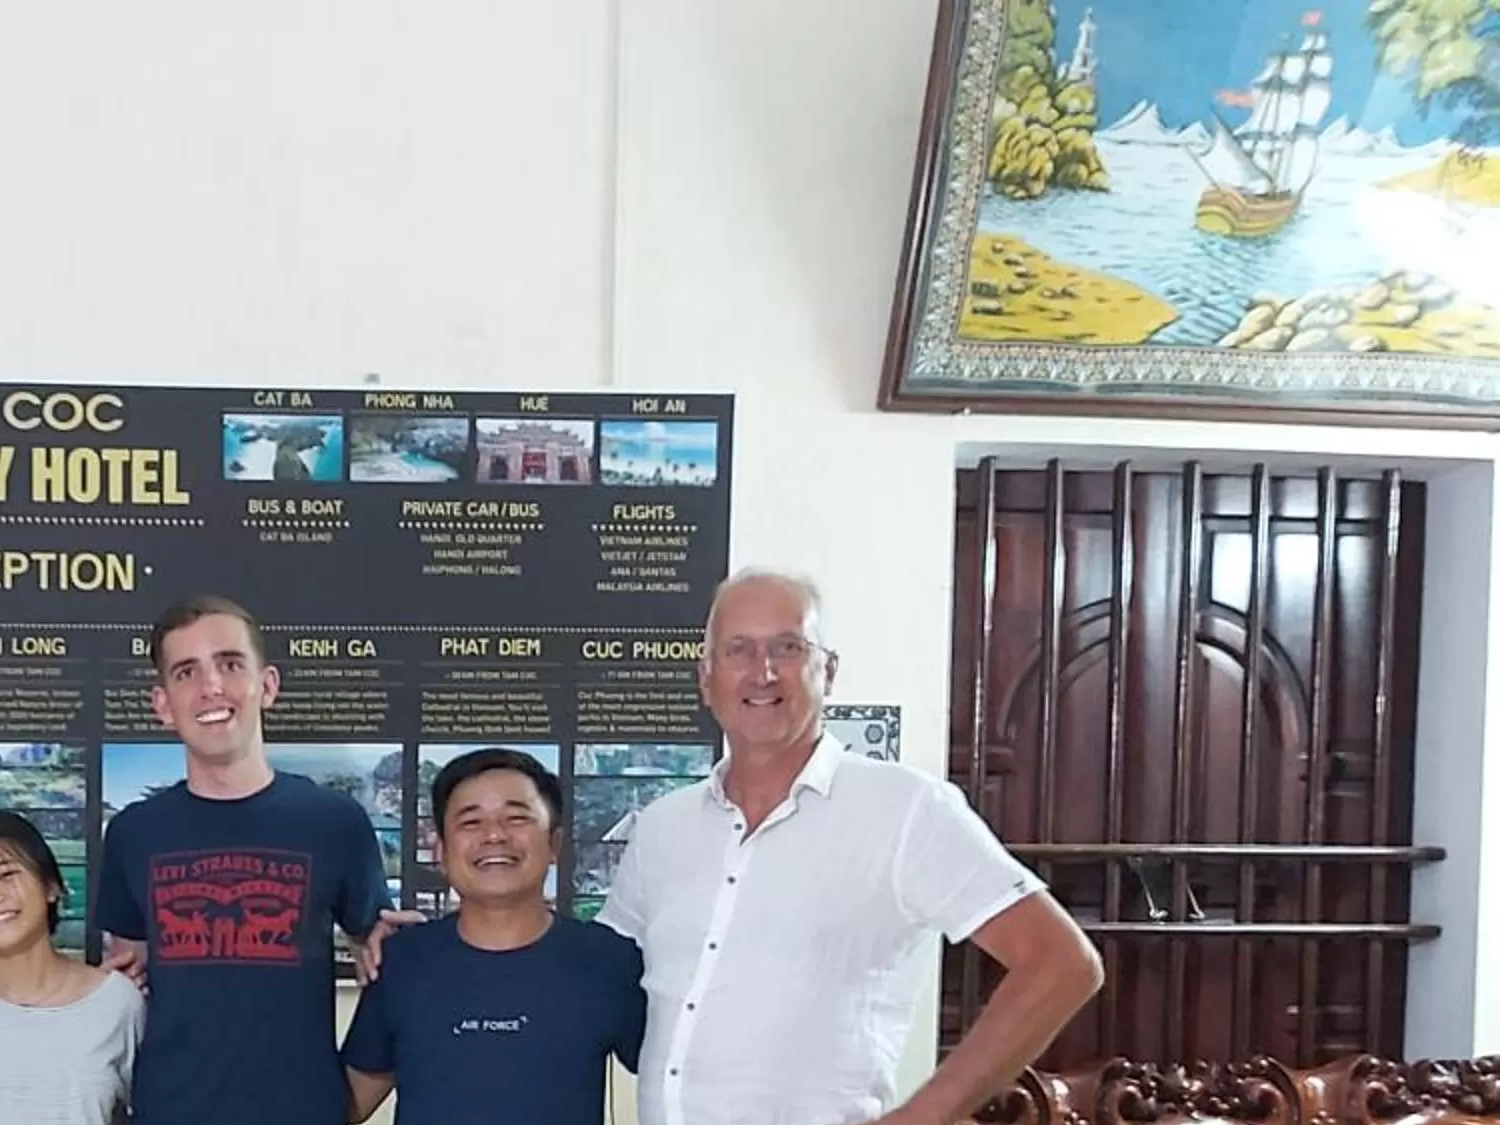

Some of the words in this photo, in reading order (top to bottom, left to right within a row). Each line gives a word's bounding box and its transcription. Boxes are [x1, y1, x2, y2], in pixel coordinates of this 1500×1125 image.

[253, 391, 283, 407] CAT
[290, 393, 314, 408] BA
[364, 393, 417, 410] PHONG
[423, 394, 454, 410] NHA
[520, 395, 549, 412] HUE
[632, 398, 659, 414] HOI
[664, 399, 687, 414] AN
[2, 391, 125, 432] COC
[30, 446, 191, 506] HOTEL
[247, 498, 281, 515] BUS
[284, 498, 297, 515] &
[301, 499, 344, 516] BOAT
[402, 501, 463, 517] PRIVATE
[612, 503, 676, 521] FLIGHTS
[11, 636, 67, 656] LONG
[289, 639, 338, 657] KENH
[346, 639, 378, 657] GA
[440, 637, 490, 656] PHAT
[499, 637, 542, 657] DIEM
[581, 640, 624, 660] CUC
[190, 854, 263, 878] STRAUSS
[460, 1020, 480, 1031] AIR
[482, 1019, 520, 1031] FORCE
